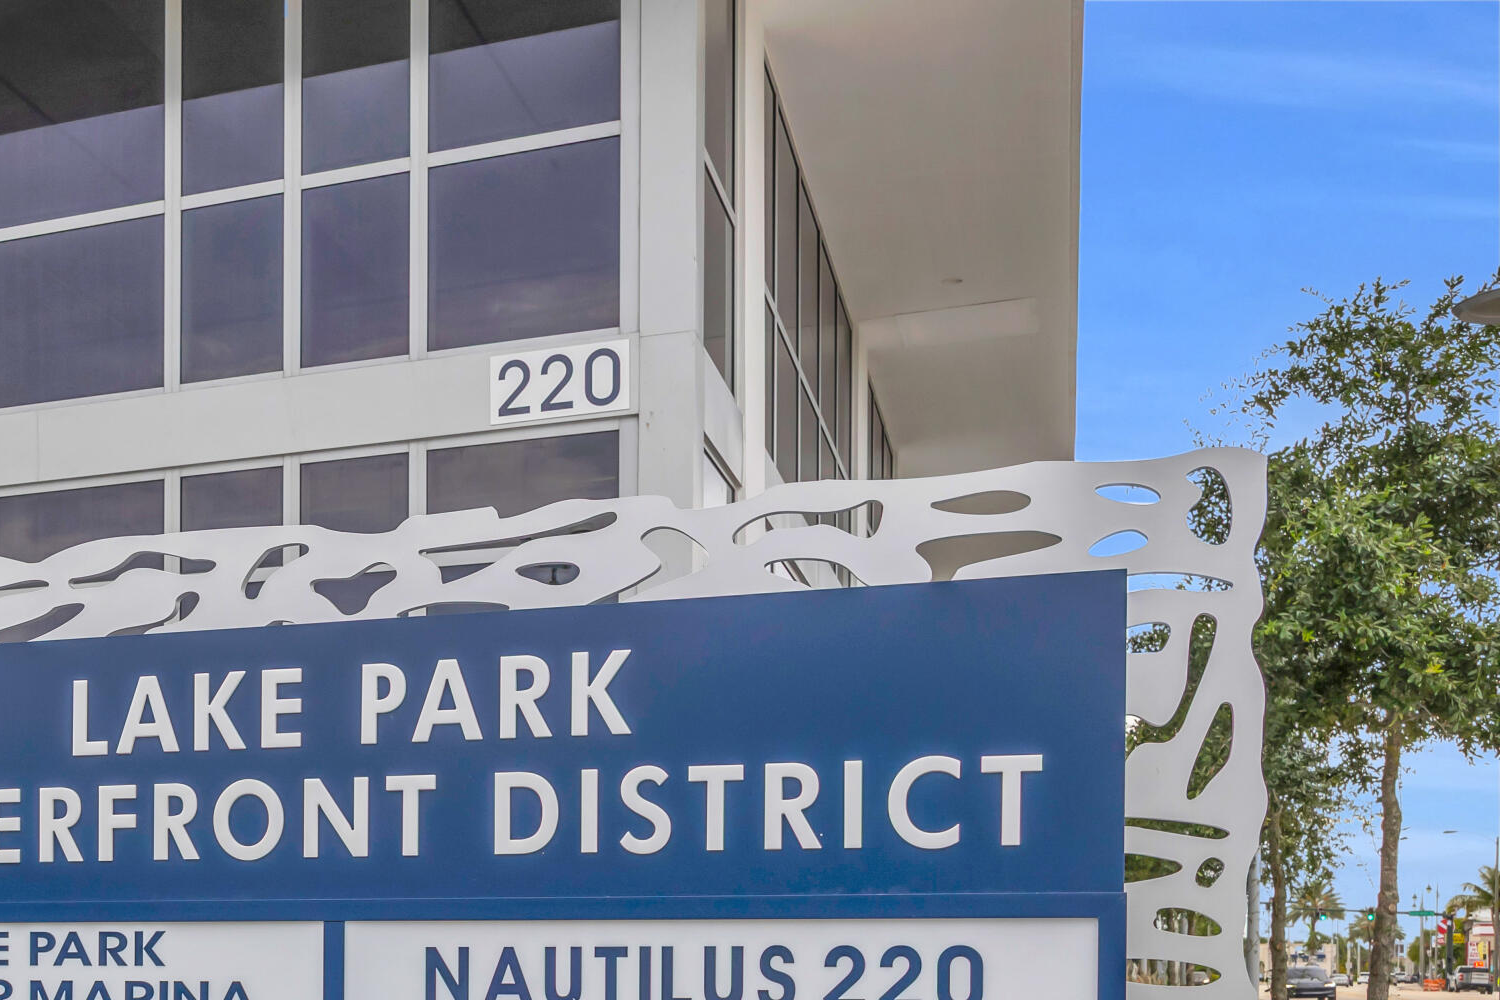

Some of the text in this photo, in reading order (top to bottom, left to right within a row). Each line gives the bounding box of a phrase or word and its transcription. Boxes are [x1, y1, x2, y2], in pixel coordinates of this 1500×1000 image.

[498, 347, 621, 417] 220
[73, 649, 632, 756] LAKE PARK
[495, 754, 1043, 856] DISTRICT
[29, 930, 166, 967] PARK
